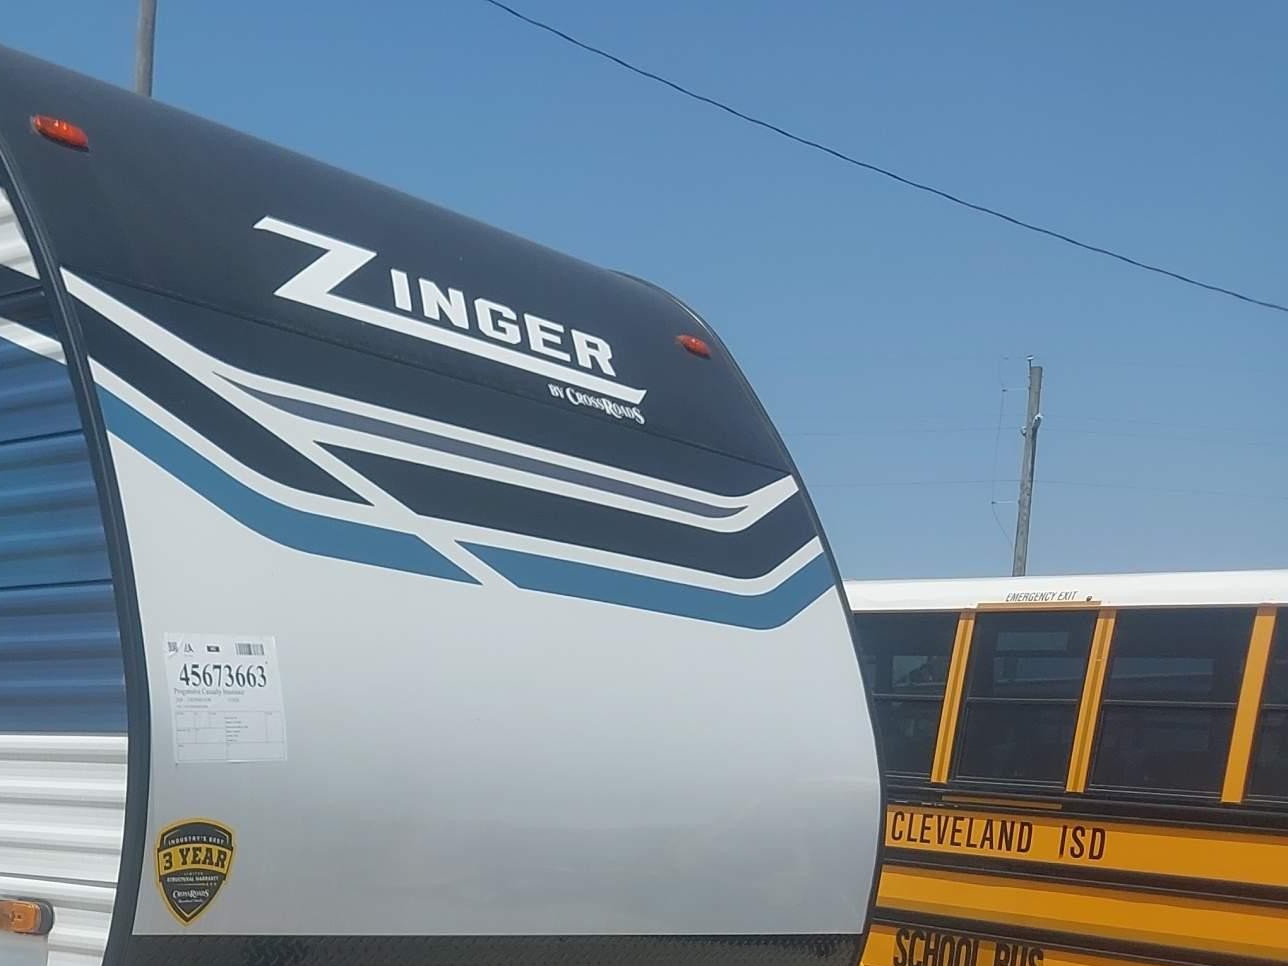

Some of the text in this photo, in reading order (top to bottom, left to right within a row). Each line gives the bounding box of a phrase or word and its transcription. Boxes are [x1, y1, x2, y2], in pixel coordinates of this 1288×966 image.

[253, 216, 647, 404] ZINGER
[1005, 590, 1079, 602] EMERGENCY EXIT
[179, 664, 267, 688] 45673663
[891, 811, 1106, 860] CLEVELAND ISD
[163, 846, 227, 871] 3 YEAR
